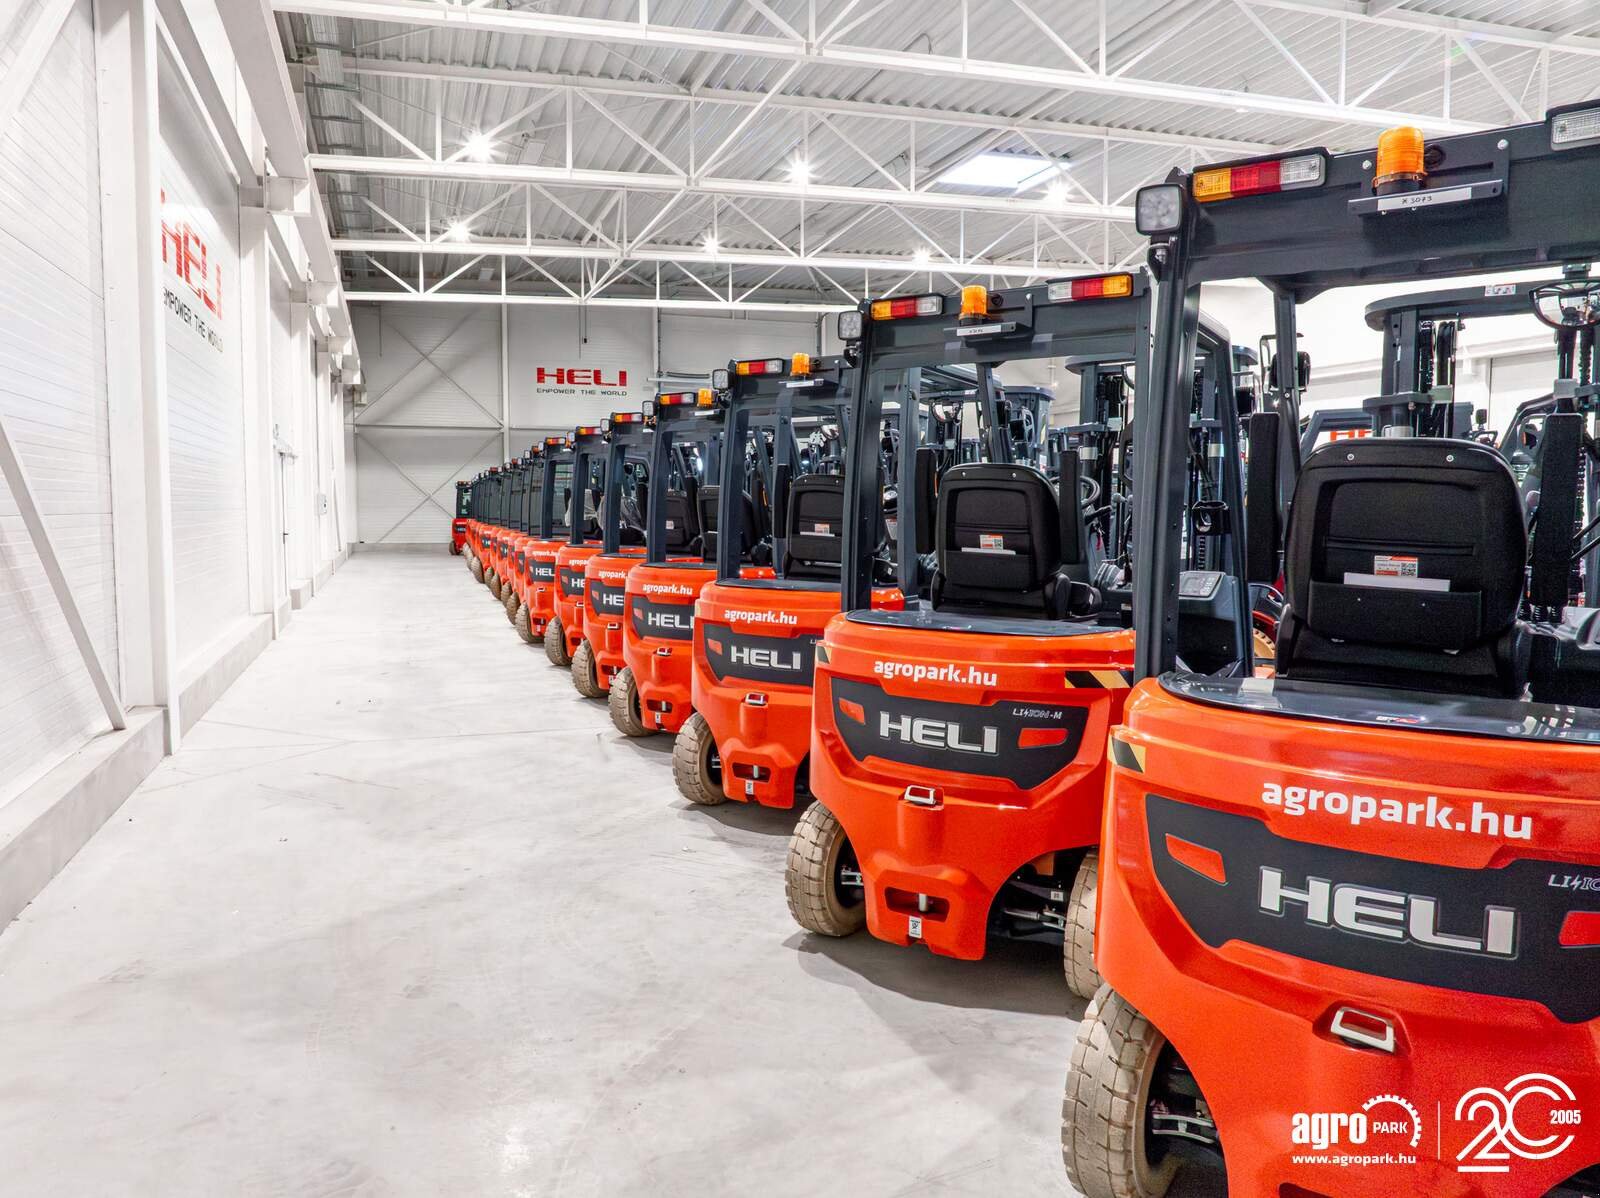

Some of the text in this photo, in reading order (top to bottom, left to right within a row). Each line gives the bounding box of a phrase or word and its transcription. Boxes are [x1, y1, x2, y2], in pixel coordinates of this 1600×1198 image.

[194, 314, 206, 339] THE
[536, 367, 627, 387] HELI
[536, 387, 576, 395] EMPOWER
[642, 583, 693, 596] agropark.hu
[724, 609, 798, 625] agropark.hu
[730, 644, 802, 671] HELI
[873, 660, 998, 687] agropark.hu
[879, 710, 1000, 757] HELI
[1261, 782, 1533, 840] agropark.hu
[1258, 866, 1520, 959] HELI
